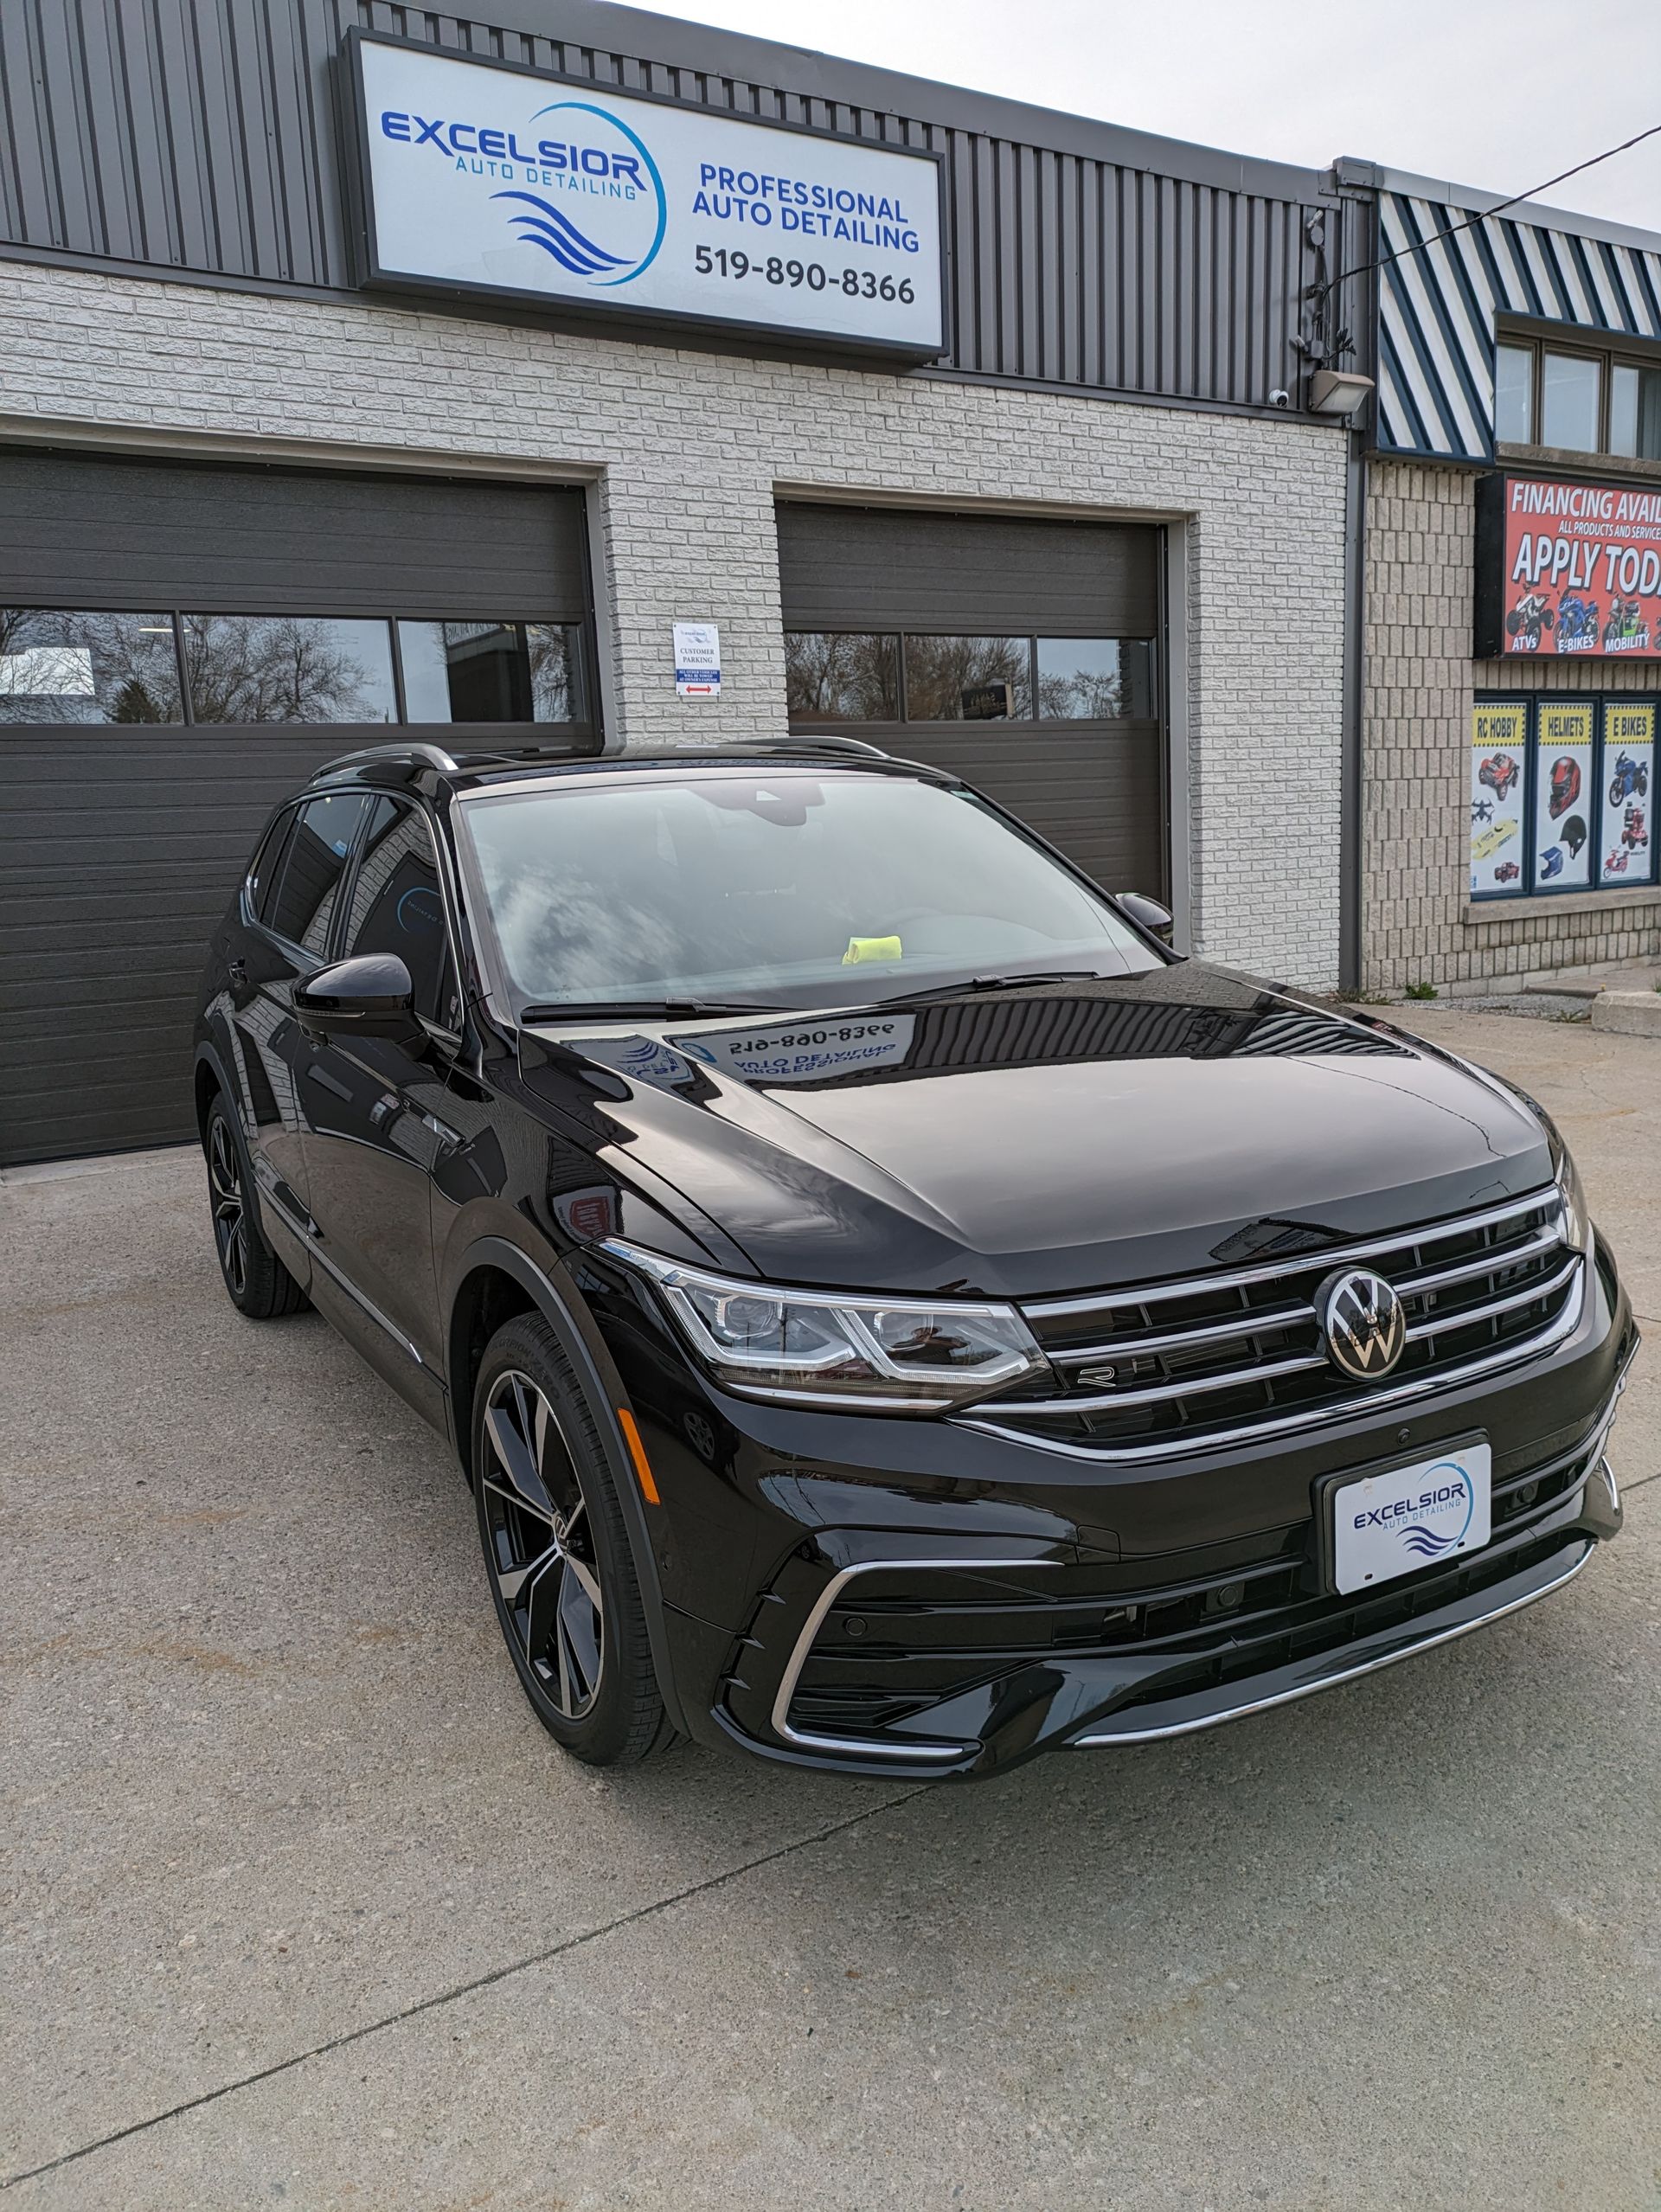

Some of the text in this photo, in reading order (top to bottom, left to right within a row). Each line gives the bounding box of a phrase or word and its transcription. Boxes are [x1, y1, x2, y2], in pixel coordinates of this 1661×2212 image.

[381, 111, 648, 192] EXCELSIOR
[455, 156, 637, 201] AUTO DETAILING
[700, 163, 909, 224] PROFESSIONAL
[692, 190, 920, 253] AUTO DETAILING
[694, 244, 915, 305] 519-890-8366
[1511, 482, 1614, 520] FINANCING
[1558, 519, 1574, 535] ALL
[1574, 521, 1614, 537] PRODUCTS
[1613, 524, 1631, 538] AND
[1511, 533, 1661, 597] APPLY TOD
[1511, 632, 1651, 654] ATVs E-BIKES MOBILITY
[1477, 716, 1517, 739] RC HOBBY
[1548, 715, 1584, 738] HELMETS
[1613, 716, 1647, 736] E BIKES
[1354, 1482, 1466, 1529] EXCELSIOR
[1382, 1497, 1462, 1531] AUTO DETAILING
